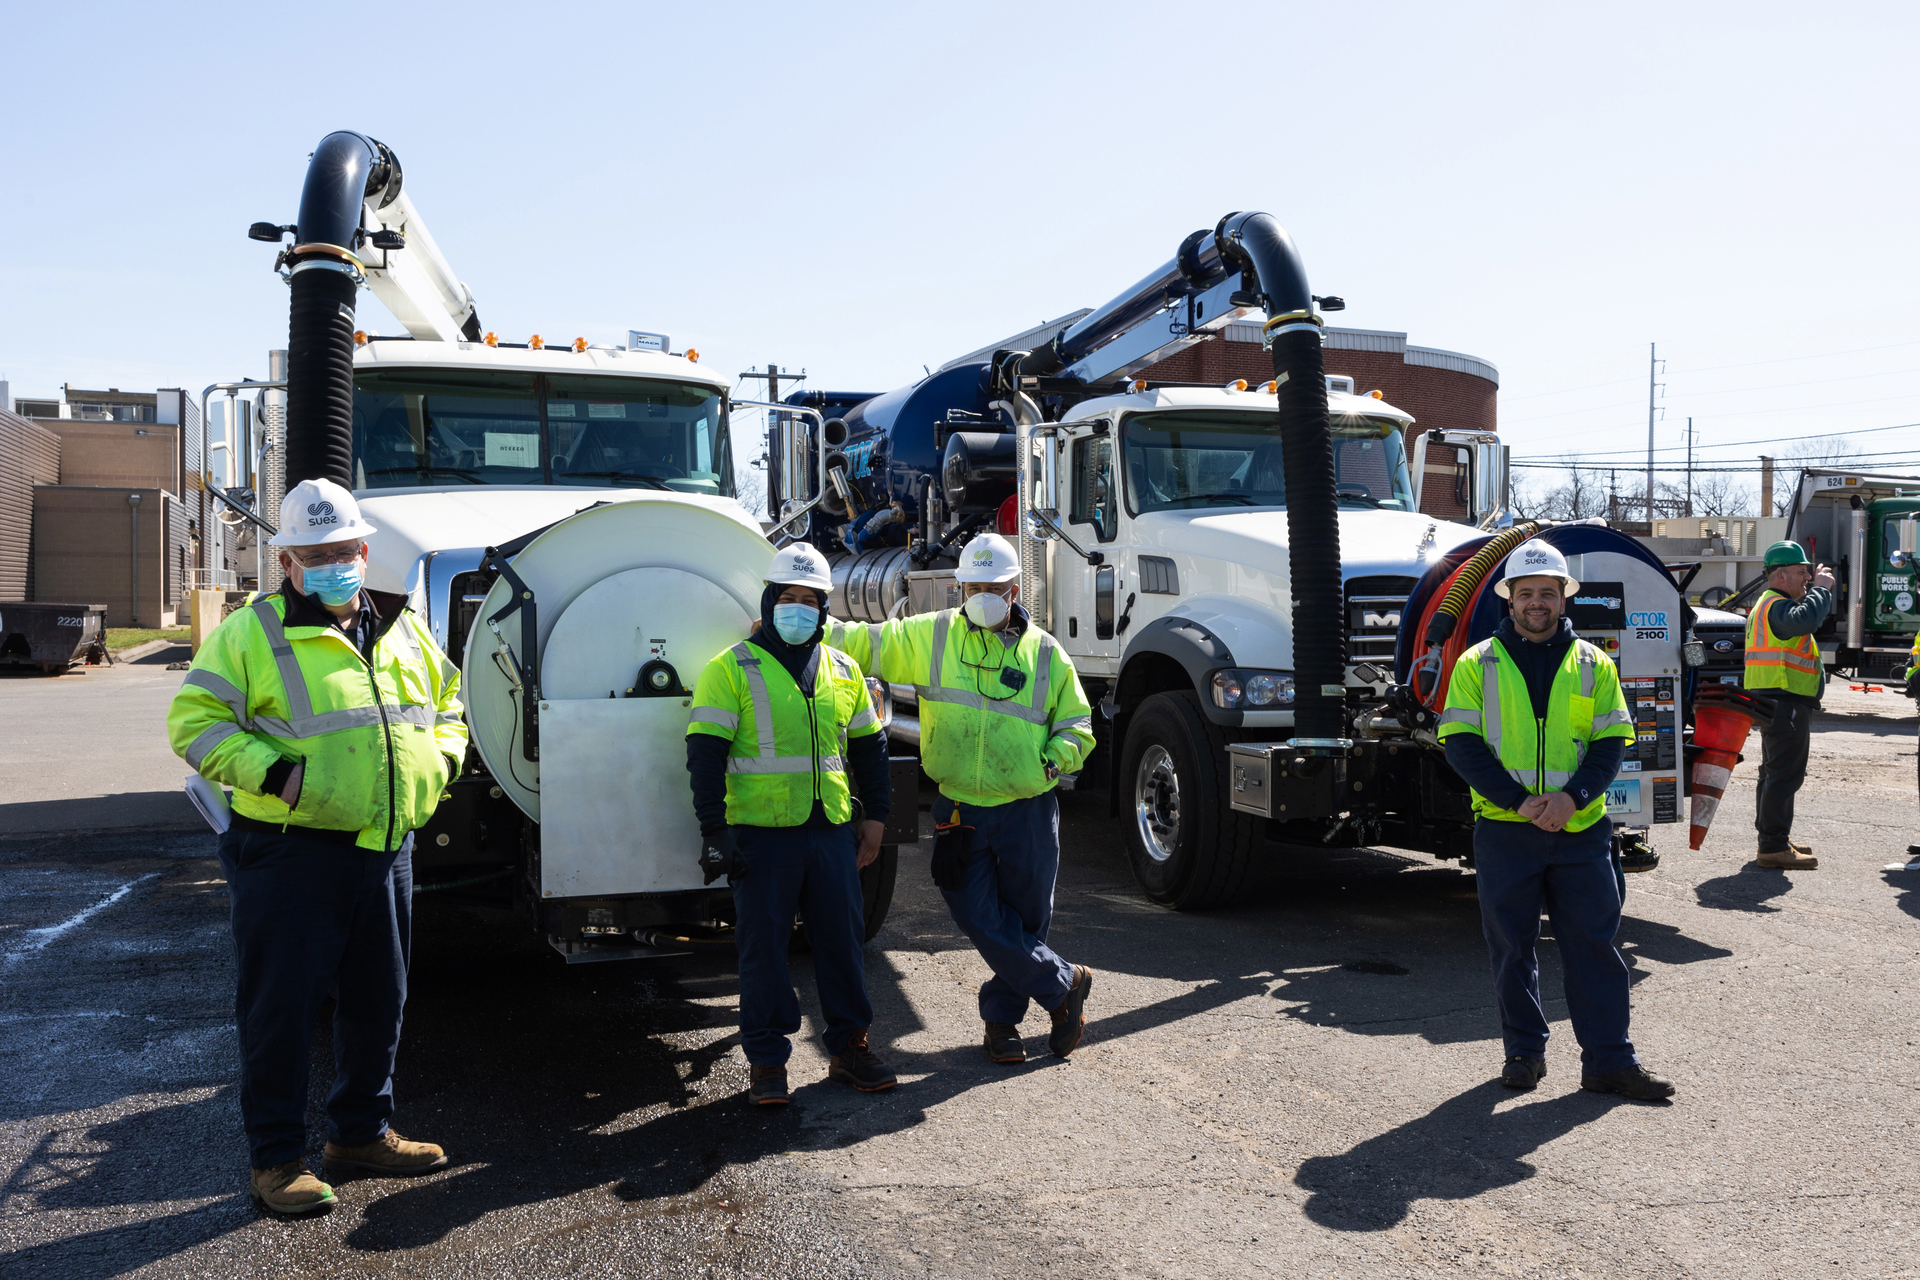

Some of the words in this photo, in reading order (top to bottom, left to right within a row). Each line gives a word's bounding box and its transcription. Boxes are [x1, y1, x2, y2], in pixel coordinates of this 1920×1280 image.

[1827, 477, 1843, 487] 624
[1881, 576, 1909, 584] PUBLIC
[1881, 584, 1909, 592] WORKS
